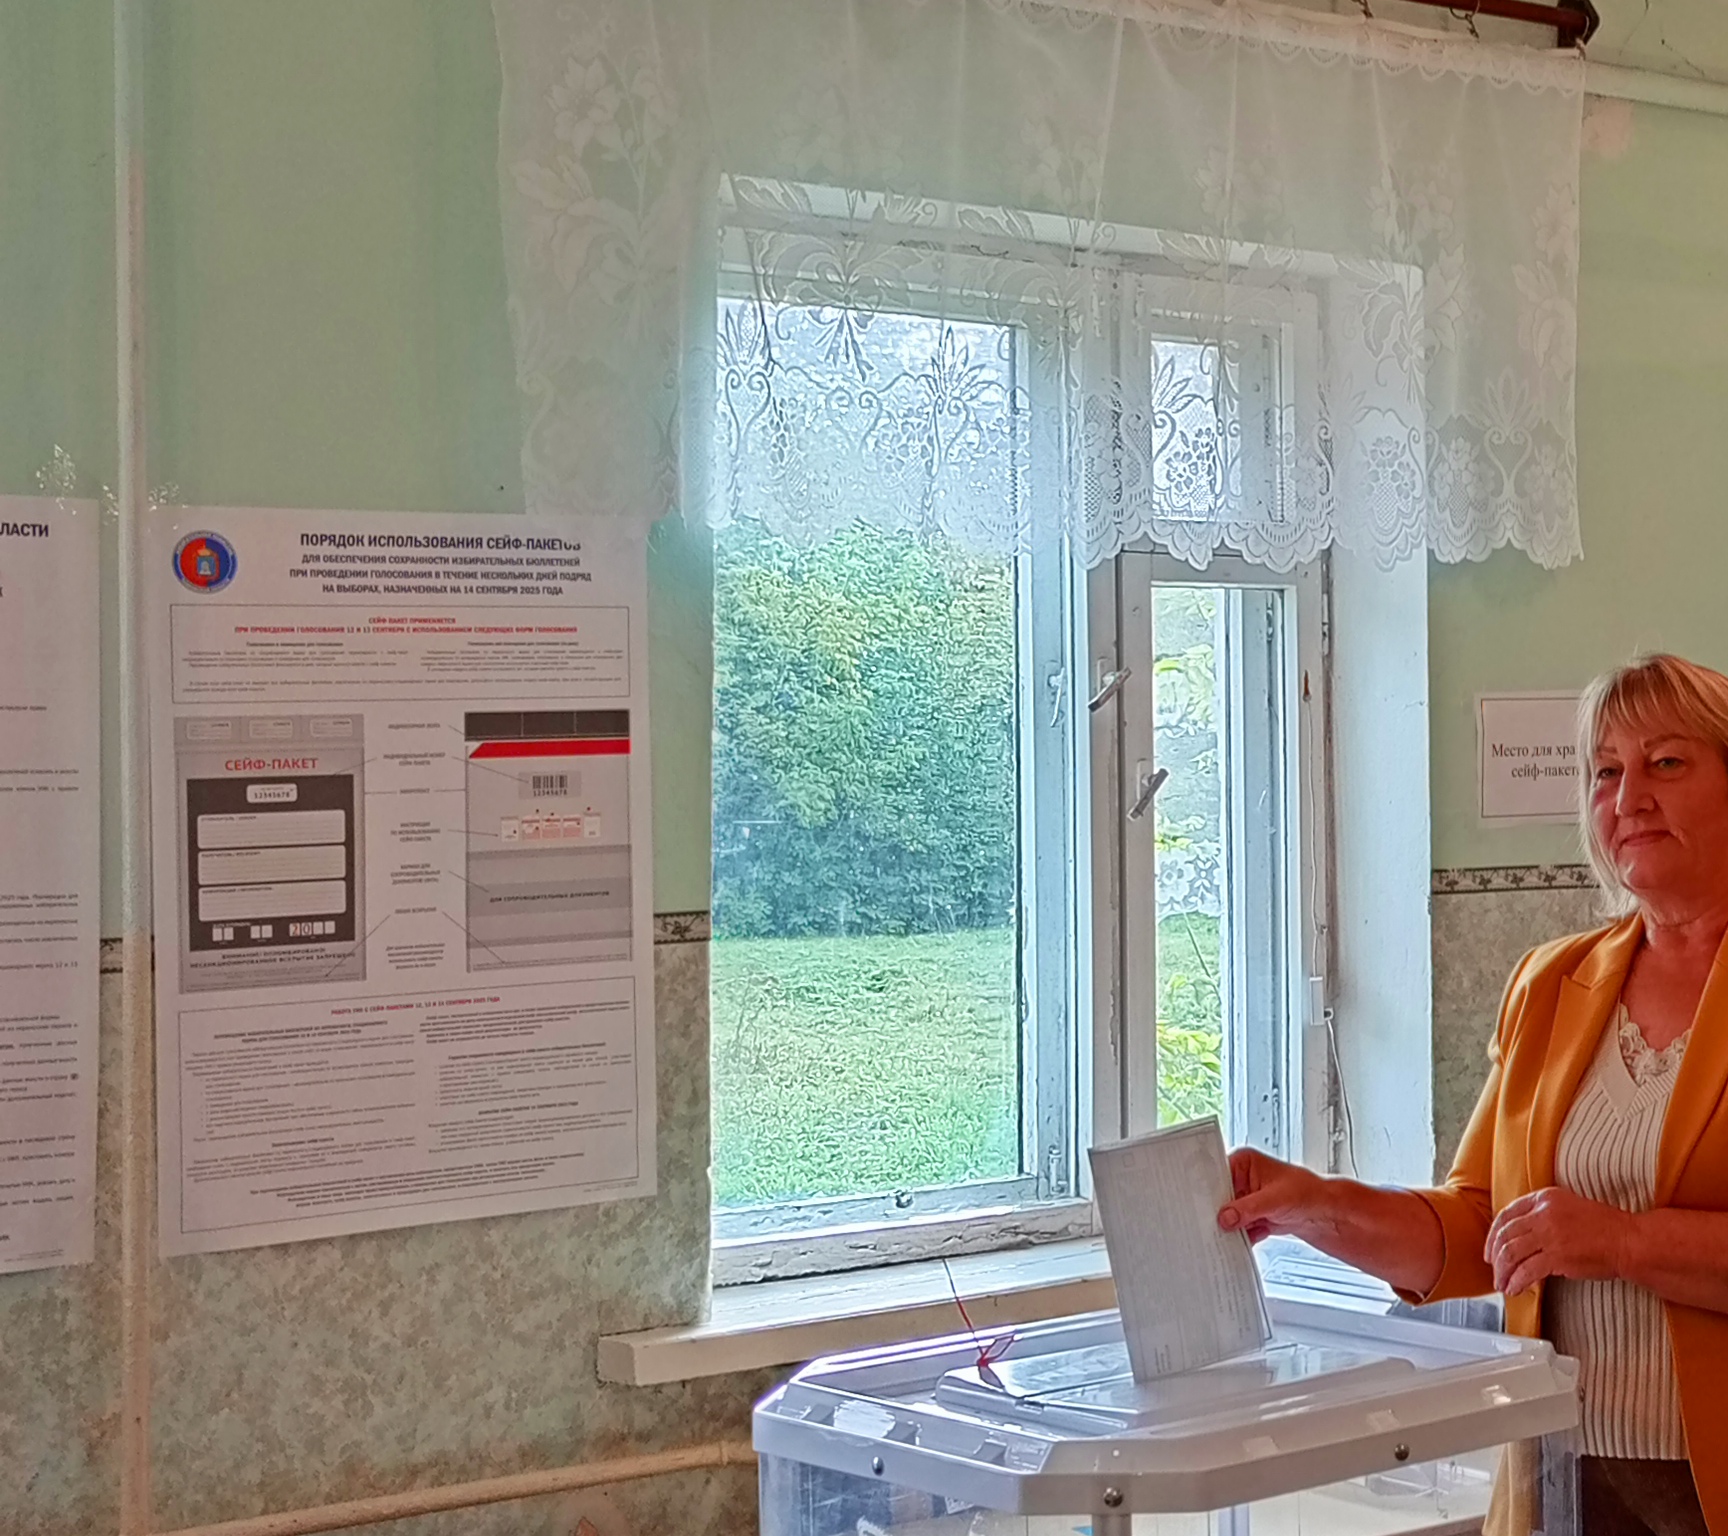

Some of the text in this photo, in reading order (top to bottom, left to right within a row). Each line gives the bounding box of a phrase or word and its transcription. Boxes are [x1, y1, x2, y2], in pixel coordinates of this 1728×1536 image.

[300, 533, 365, 548] ПОРЯДОК
[368, 534, 483, 549] ИСПОЛЬЗОВАНИЯ
[302, 554, 580, 567] ДЛЯ ОБЕСПЕЧЕНИЯ СОХРАННОСТИ ИЗБИРАТЕЛЬНЫХ БЮЛЛЕТЕНЕЙ
[289, 569, 592, 582] ПРИ ПРОВЕДЕНИИ ГОЛОСОВАНИЯ В ТЕЧЕНИЕ НЕСКОЛЬКИХ ДНЕЙ ПОДРЯД
[322, 584, 563, 596] НА ВЫБОРАХ, НАЗНАЧЕННЫХ НА 14 СЕНТЯБРЯ 2025 ГОДА
[1491, 743, 1576, 760] Место для хра
[225, 757, 318, 771] СЕЙФ-ПАКЕТ
